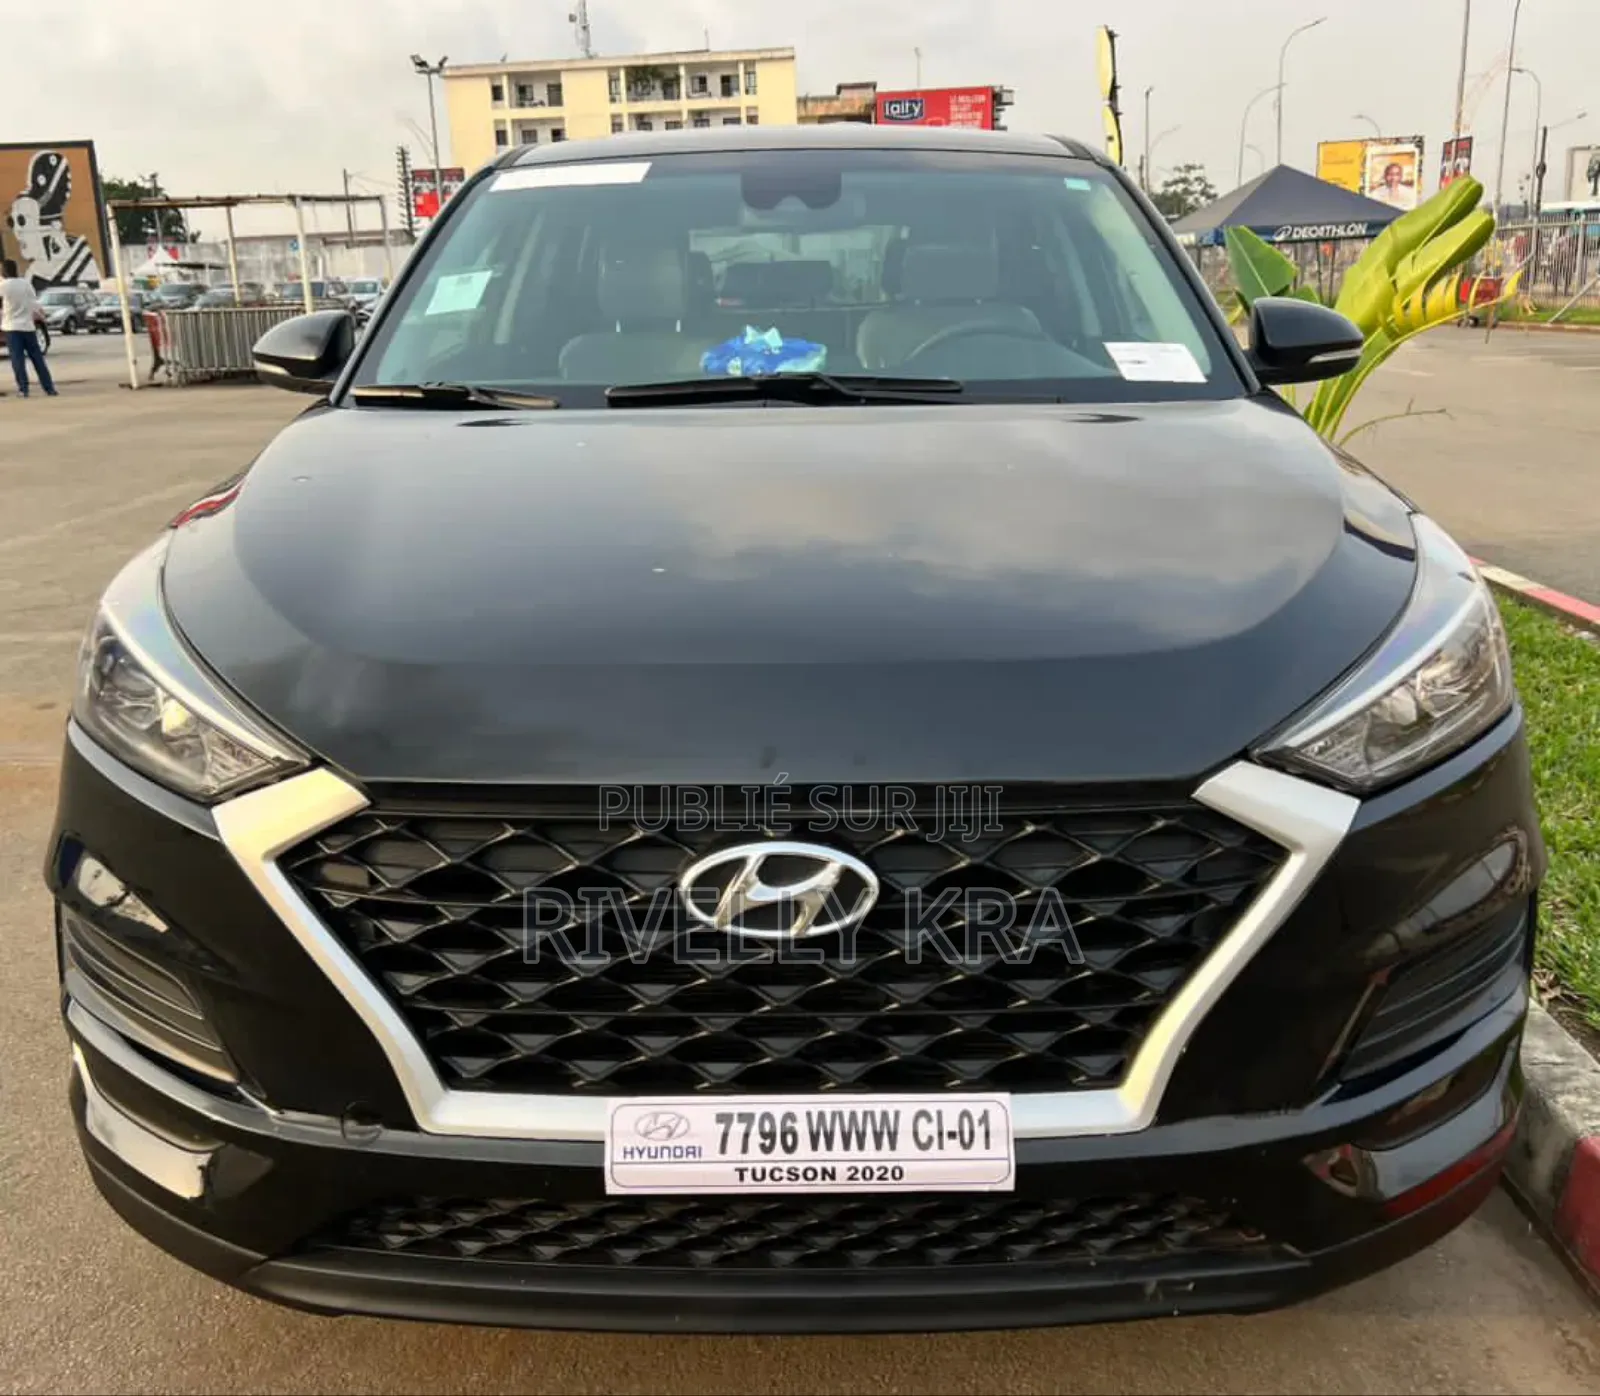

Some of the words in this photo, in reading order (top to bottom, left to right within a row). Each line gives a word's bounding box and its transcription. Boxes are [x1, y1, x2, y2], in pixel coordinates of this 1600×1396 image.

[1292, 223, 1368, 239] DECATHLON
[715, 1111, 799, 1155] 7796
[806, 1110, 900, 1152] WWW
[912, 1109, 991, 1152] CI-01
[623, 1146, 702, 1159] HYUNDAI
[735, 1166, 837, 1182] TUCSON
[846, 1165, 904, 1181] 2020
